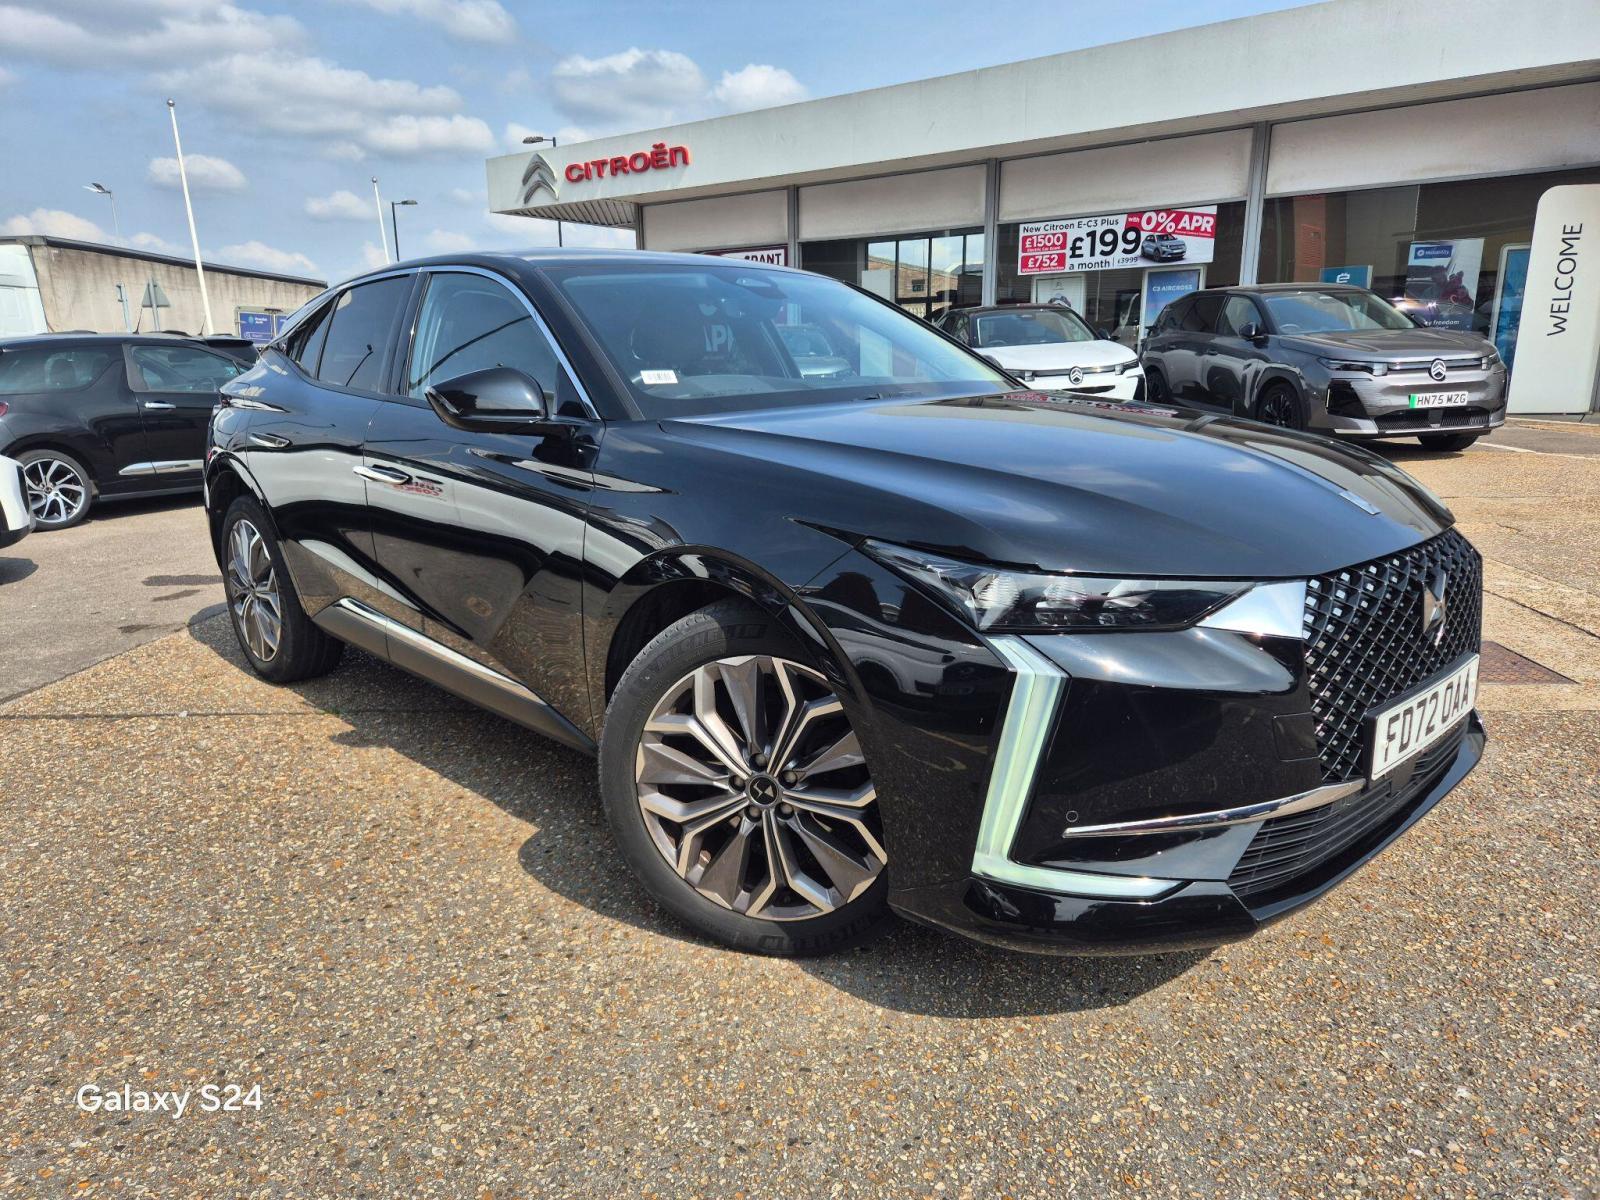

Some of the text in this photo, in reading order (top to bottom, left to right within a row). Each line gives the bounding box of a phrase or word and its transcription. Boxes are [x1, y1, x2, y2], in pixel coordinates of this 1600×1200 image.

[1043, 223, 1075, 231] Citroen
[1077, 219, 1098, 228] E-C3
[1101, 217, 1119, 226] Plus
[1141, 210, 1176, 233] 0%
[1177, 214, 1215, 232] APR
[1025, 233, 1063, 248] £1500
[1069, 227, 1141, 258] £199
[1028, 254, 1059, 268] £752
[1077, 259, 1111, 269] month
[1546, 222, 1583, 337] WELCOME
[1432, 318, 1460, 326] freedom
[1416, 393, 1466, 406] HN75 MZG
[1383, 667, 1471, 762] FD72 OAA
